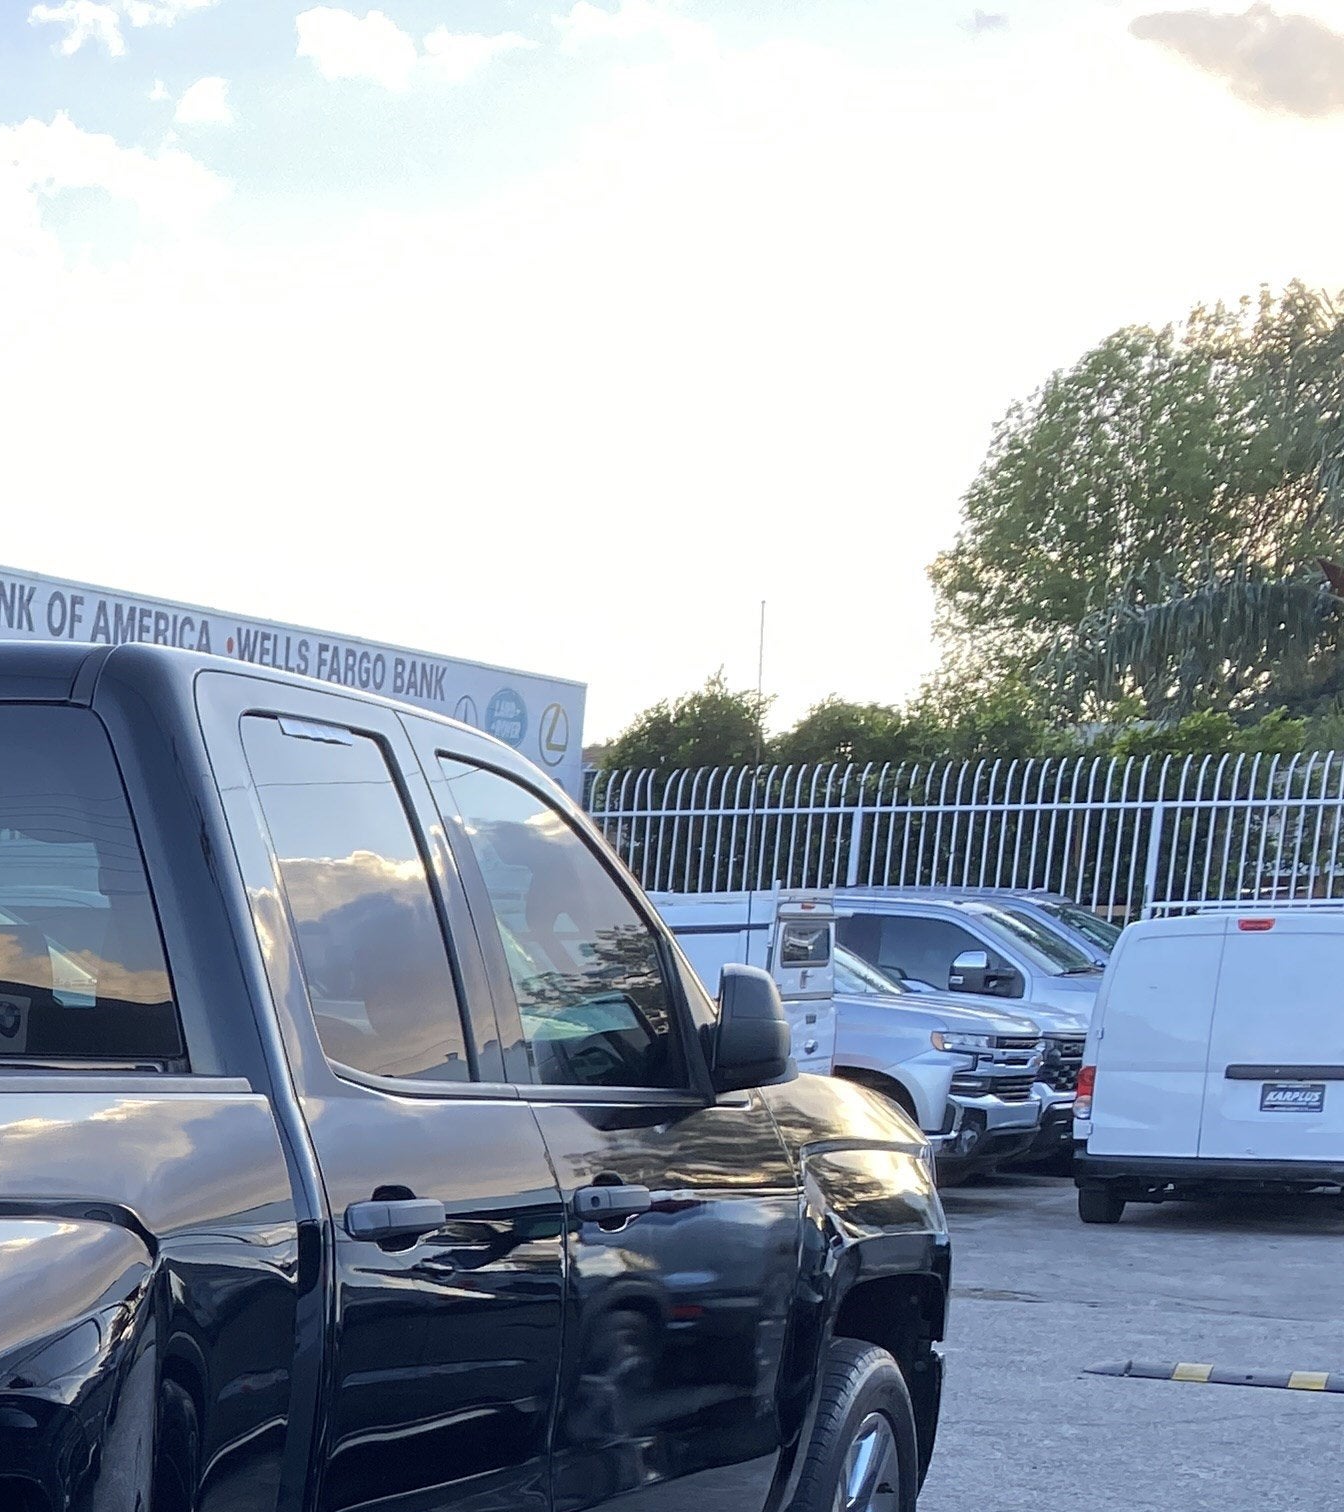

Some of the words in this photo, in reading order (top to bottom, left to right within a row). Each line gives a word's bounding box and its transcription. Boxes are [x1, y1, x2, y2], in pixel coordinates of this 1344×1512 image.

[47, 591, 85, 639] OF
[90, 600, 212, 654] AMERICA
[236, 627, 309, 676] WELLS
[316, 642, 386, 690] FARGO
[393, 657, 448, 701] BANK
[1266, 1091, 1322, 1102] KARPLUS
